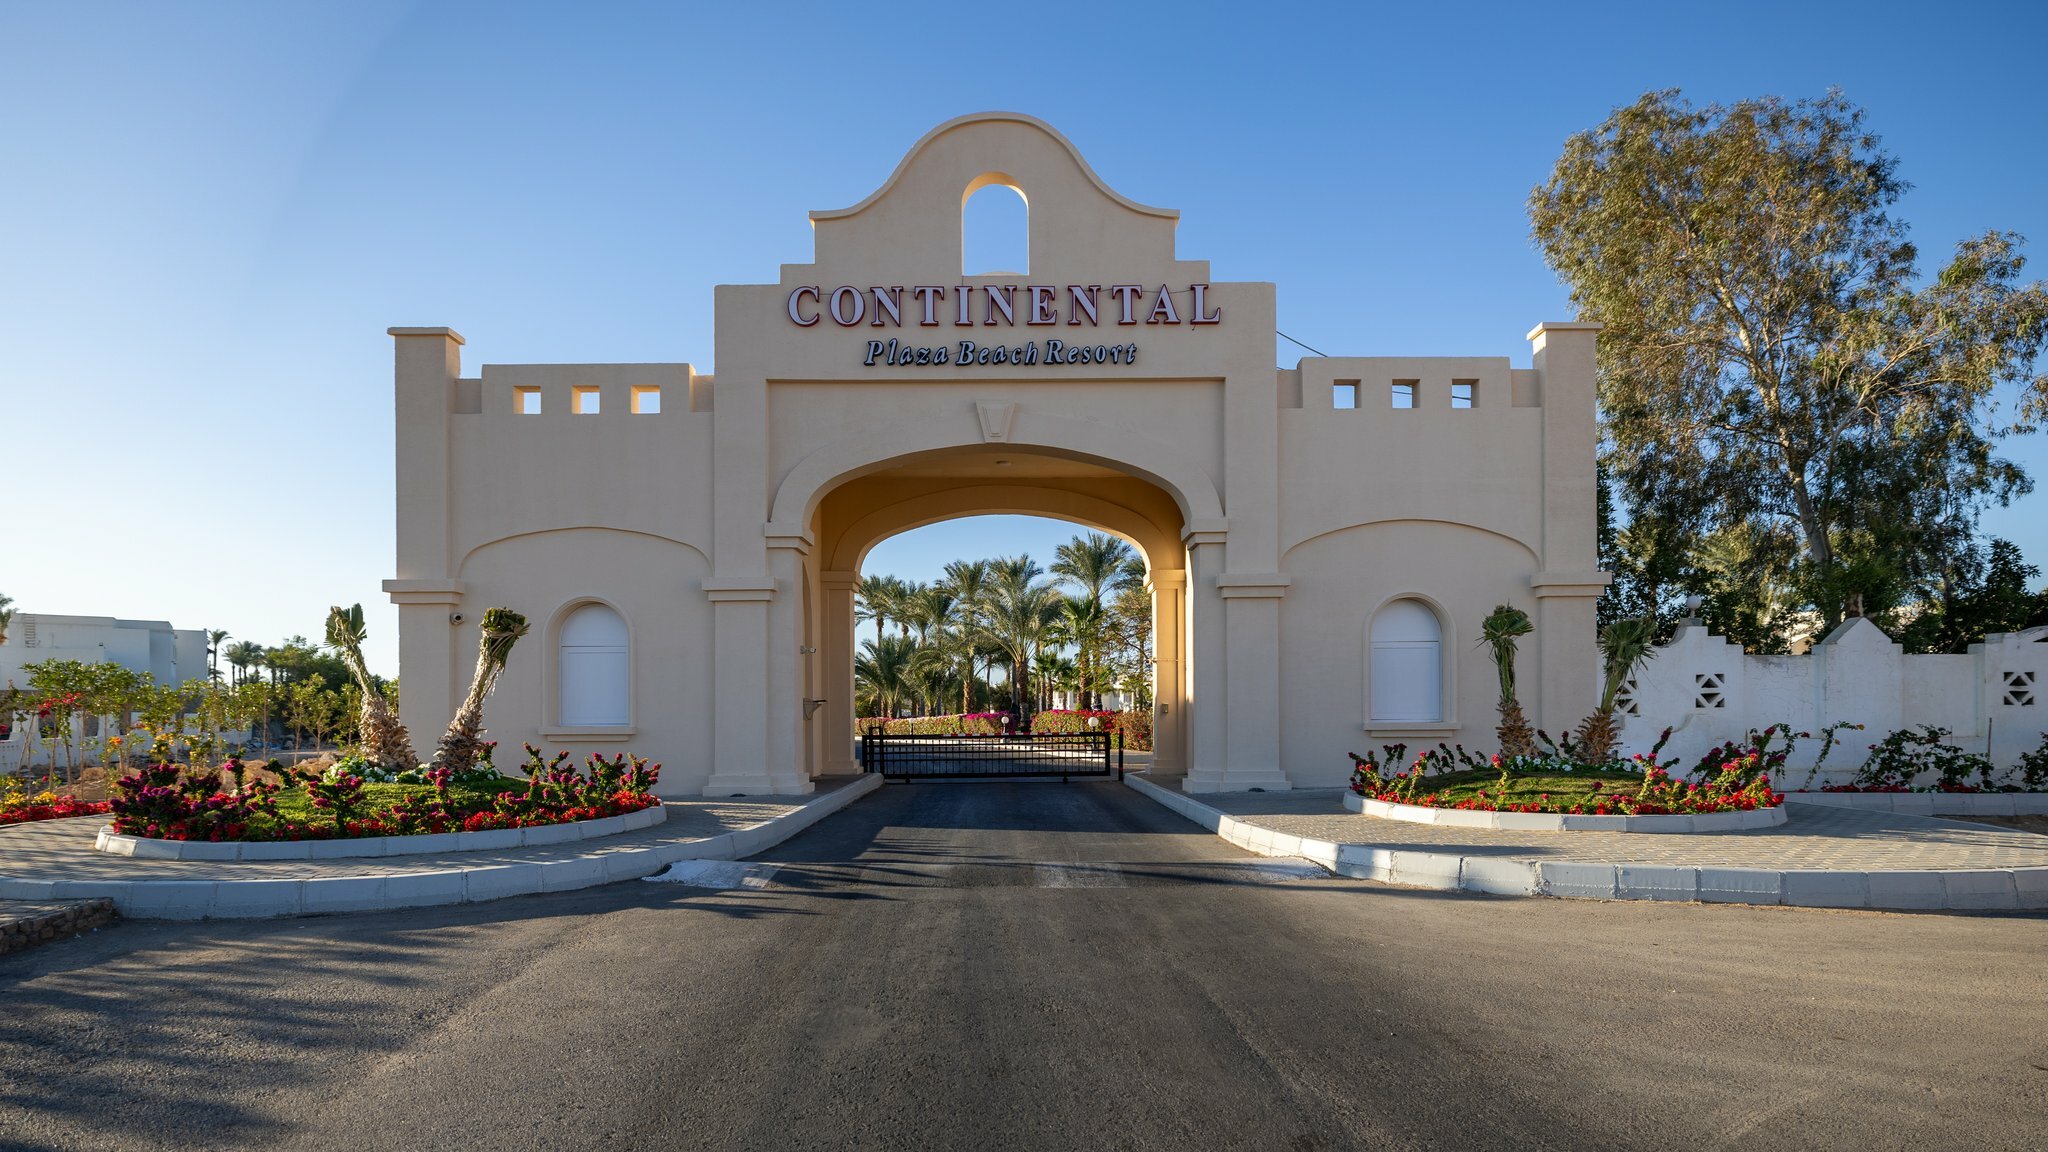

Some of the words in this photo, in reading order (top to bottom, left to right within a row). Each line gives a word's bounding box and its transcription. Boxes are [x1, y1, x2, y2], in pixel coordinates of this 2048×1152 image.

[787, 284, 1222, 327] CONTINENTAL
[863, 337, 949, 366] Plaza
[955, 340, 1038, 366] Beach
[1044, 338, 1138, 365] Resort
